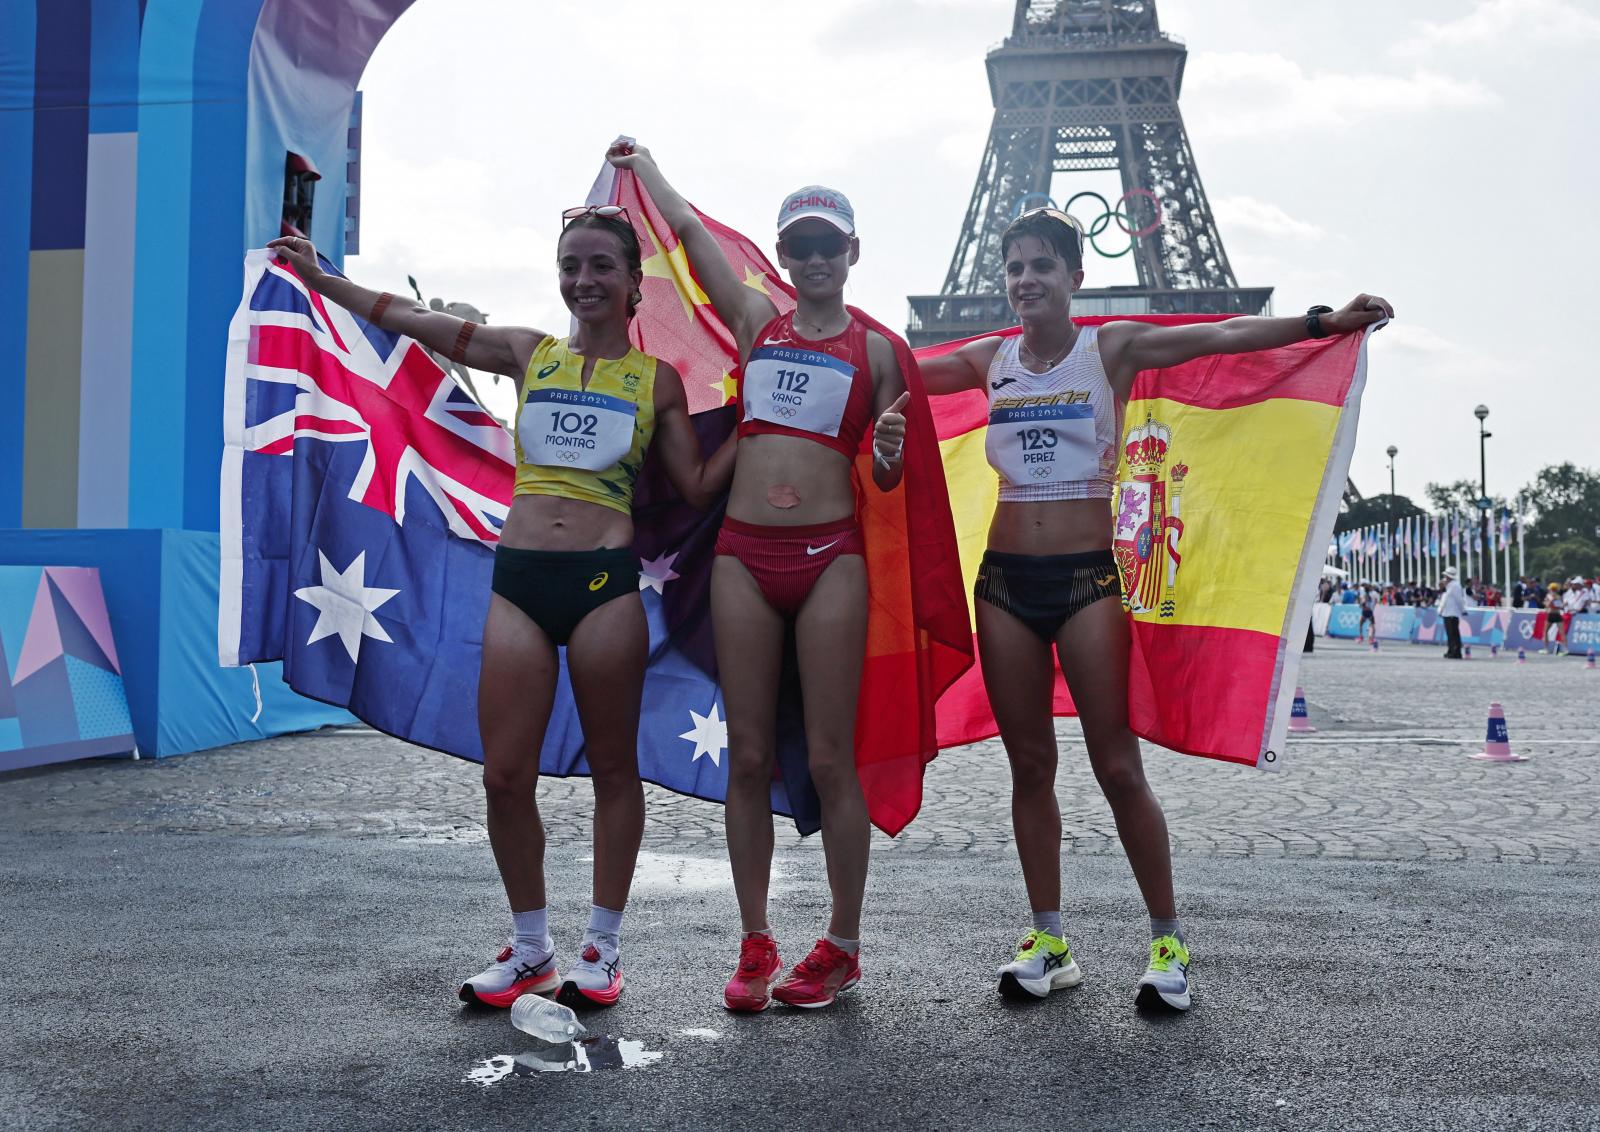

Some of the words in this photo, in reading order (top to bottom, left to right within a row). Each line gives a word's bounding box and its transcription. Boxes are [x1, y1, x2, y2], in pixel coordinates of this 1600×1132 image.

[788, 195, 837, 212] CHINA
[772, 350, 800, 360] PARIS
[802, 353, 827, 364] 2024
[777, 369, 810, 394] 112
[550, 393, 578, 402] PARIS
[581, 395, 607, 406] 2024
[771, 391, 803, 406] YANG
[1008, 410, 1035, 419] PARIS
[1038, 409, 1063, 417] 2024
[551, 411, 598, 436] 102
[545, 435, 596, 450] MONTAG
[1016, 428, 1058, 451] 123
[1023, 451, 1056, 464] PEREZ
